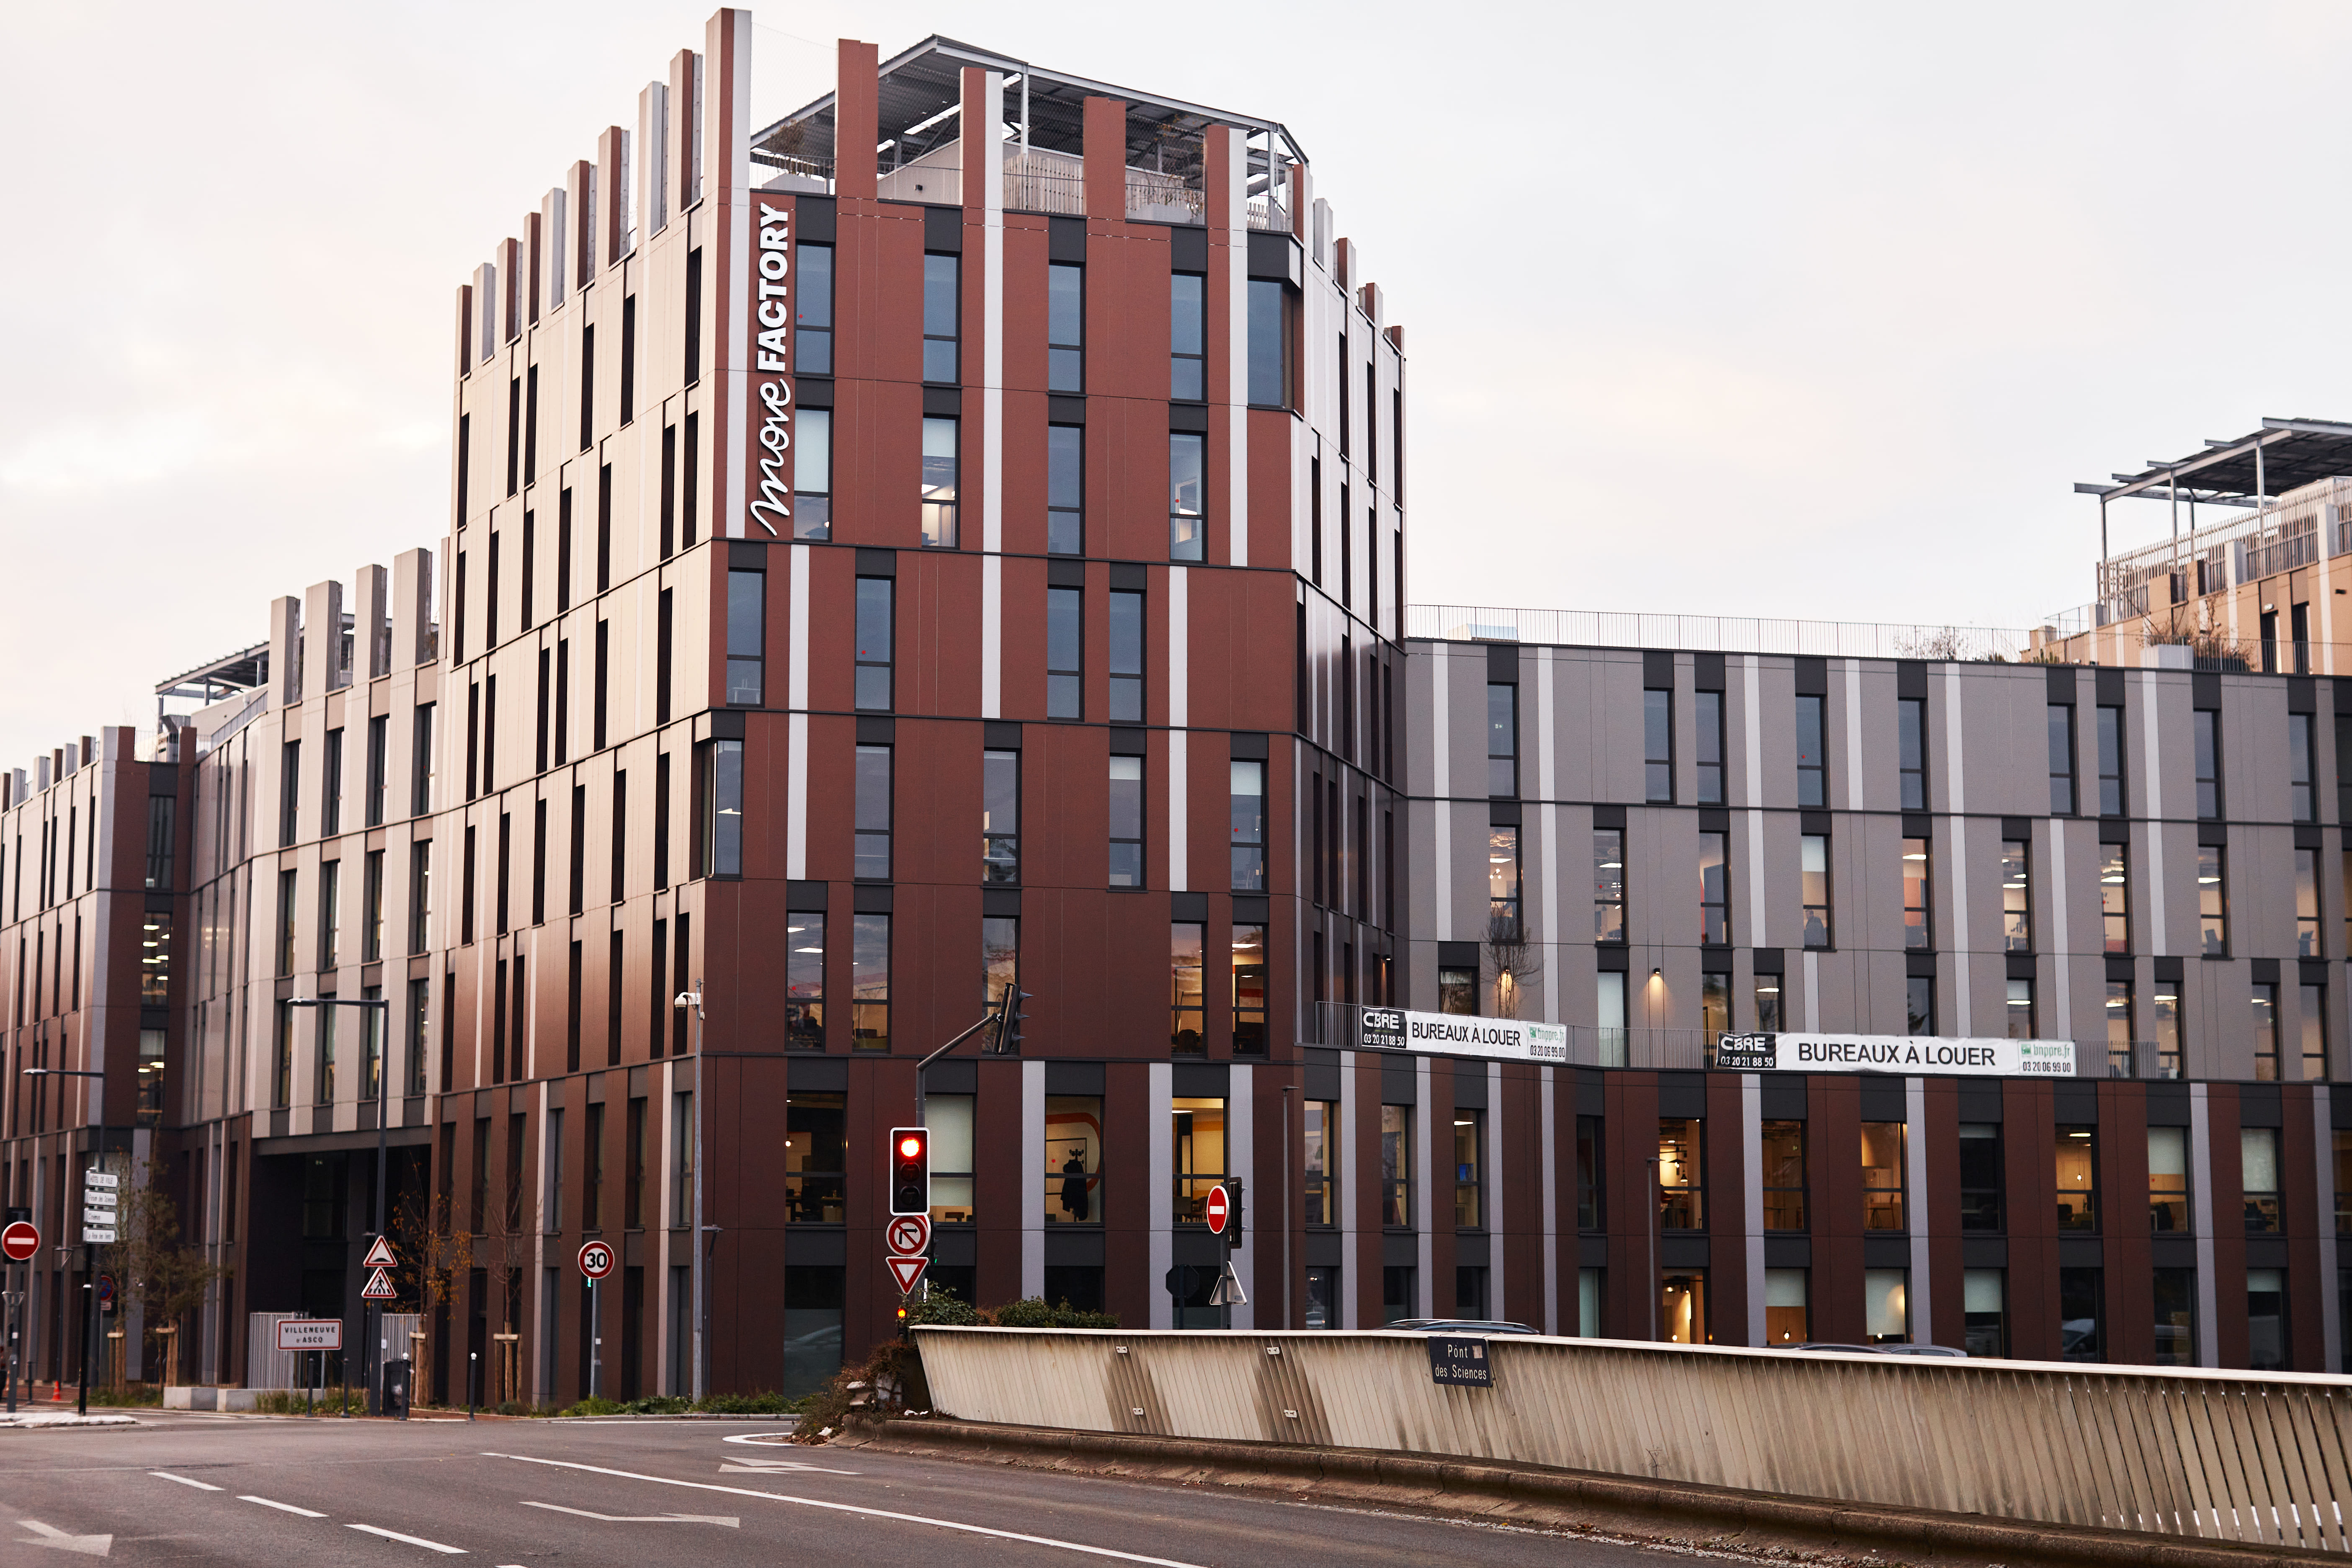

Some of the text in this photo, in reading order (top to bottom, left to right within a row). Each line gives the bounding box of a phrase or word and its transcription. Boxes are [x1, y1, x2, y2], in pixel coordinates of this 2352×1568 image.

[750, 202, 791, 536] move FACTORY
[1363, 1012, 1399, 1029] CBRE
[1364, 1033, 1405, 1046] 03 20 21 88 50
[1412, 1022, 1521, 1046] BUREAUX À LOUER
[1538, 1027, 1564, 1043] bnppre.fr
[1530, 1045, 1565, 1057] 03 20 06 99 00
[1720, 1036, 1766, 1051] CBRE
[2033, 1044, 2070, 1058] bnppre.fr
[1799, 1041, 1996, 1065] BUREAUX À LOUER
[1721, 1056, 1774, 1067] 03 20 21 88 50
[2023, 1062, 2071, 1073] 03 20 06 99 00
[586, 1252, 607, 1268] 30
[1448, 1344, 1467, 1358] Pont
[1435, 1364, 1486, 1380] des Sciences
